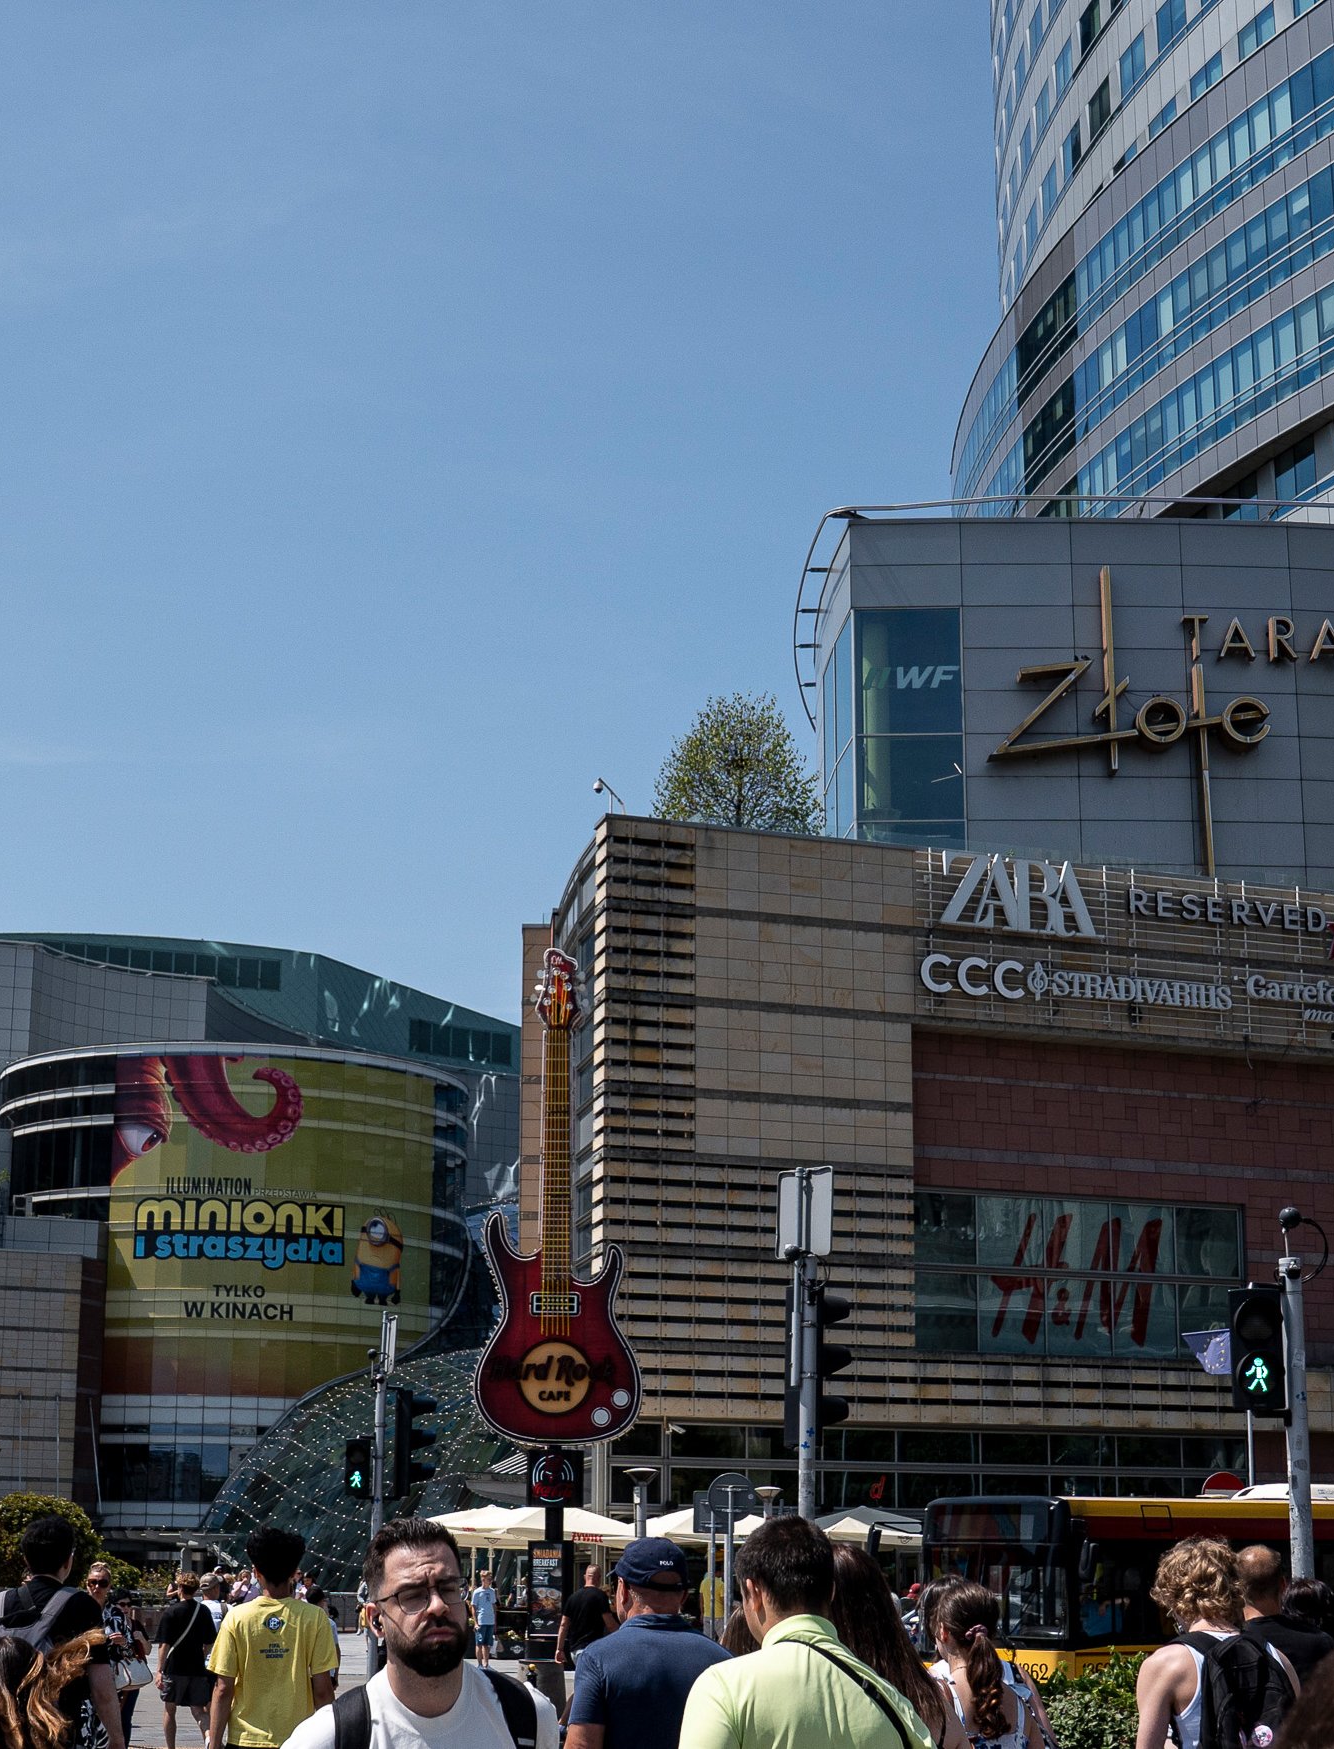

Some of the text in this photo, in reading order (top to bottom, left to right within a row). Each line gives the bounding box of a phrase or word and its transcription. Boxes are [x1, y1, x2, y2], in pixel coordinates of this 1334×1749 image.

[987, 565, 1272, 878] Złote
[940, 850, 1105, 938] ZARA
[1129, 888, 1326, 933] RESERVED
[920, 954, 1025, 1000] CCC
[1052, 970, 1233, 1011] STRADIVARIUS
[166, 1176, 252, 1196] ILLUMINATION
[254, 1187, 318, 1199] PRZEDSTAWIA
[155, 1233, 344, 1269] straszydła
[213, 1284, 266, 1298] TYLKO
[990, 1212, 1163, 1348] H&M
[184, 1301, 294, 1321] W KINACH
[538, 1390, 571, 1402] CAFE
